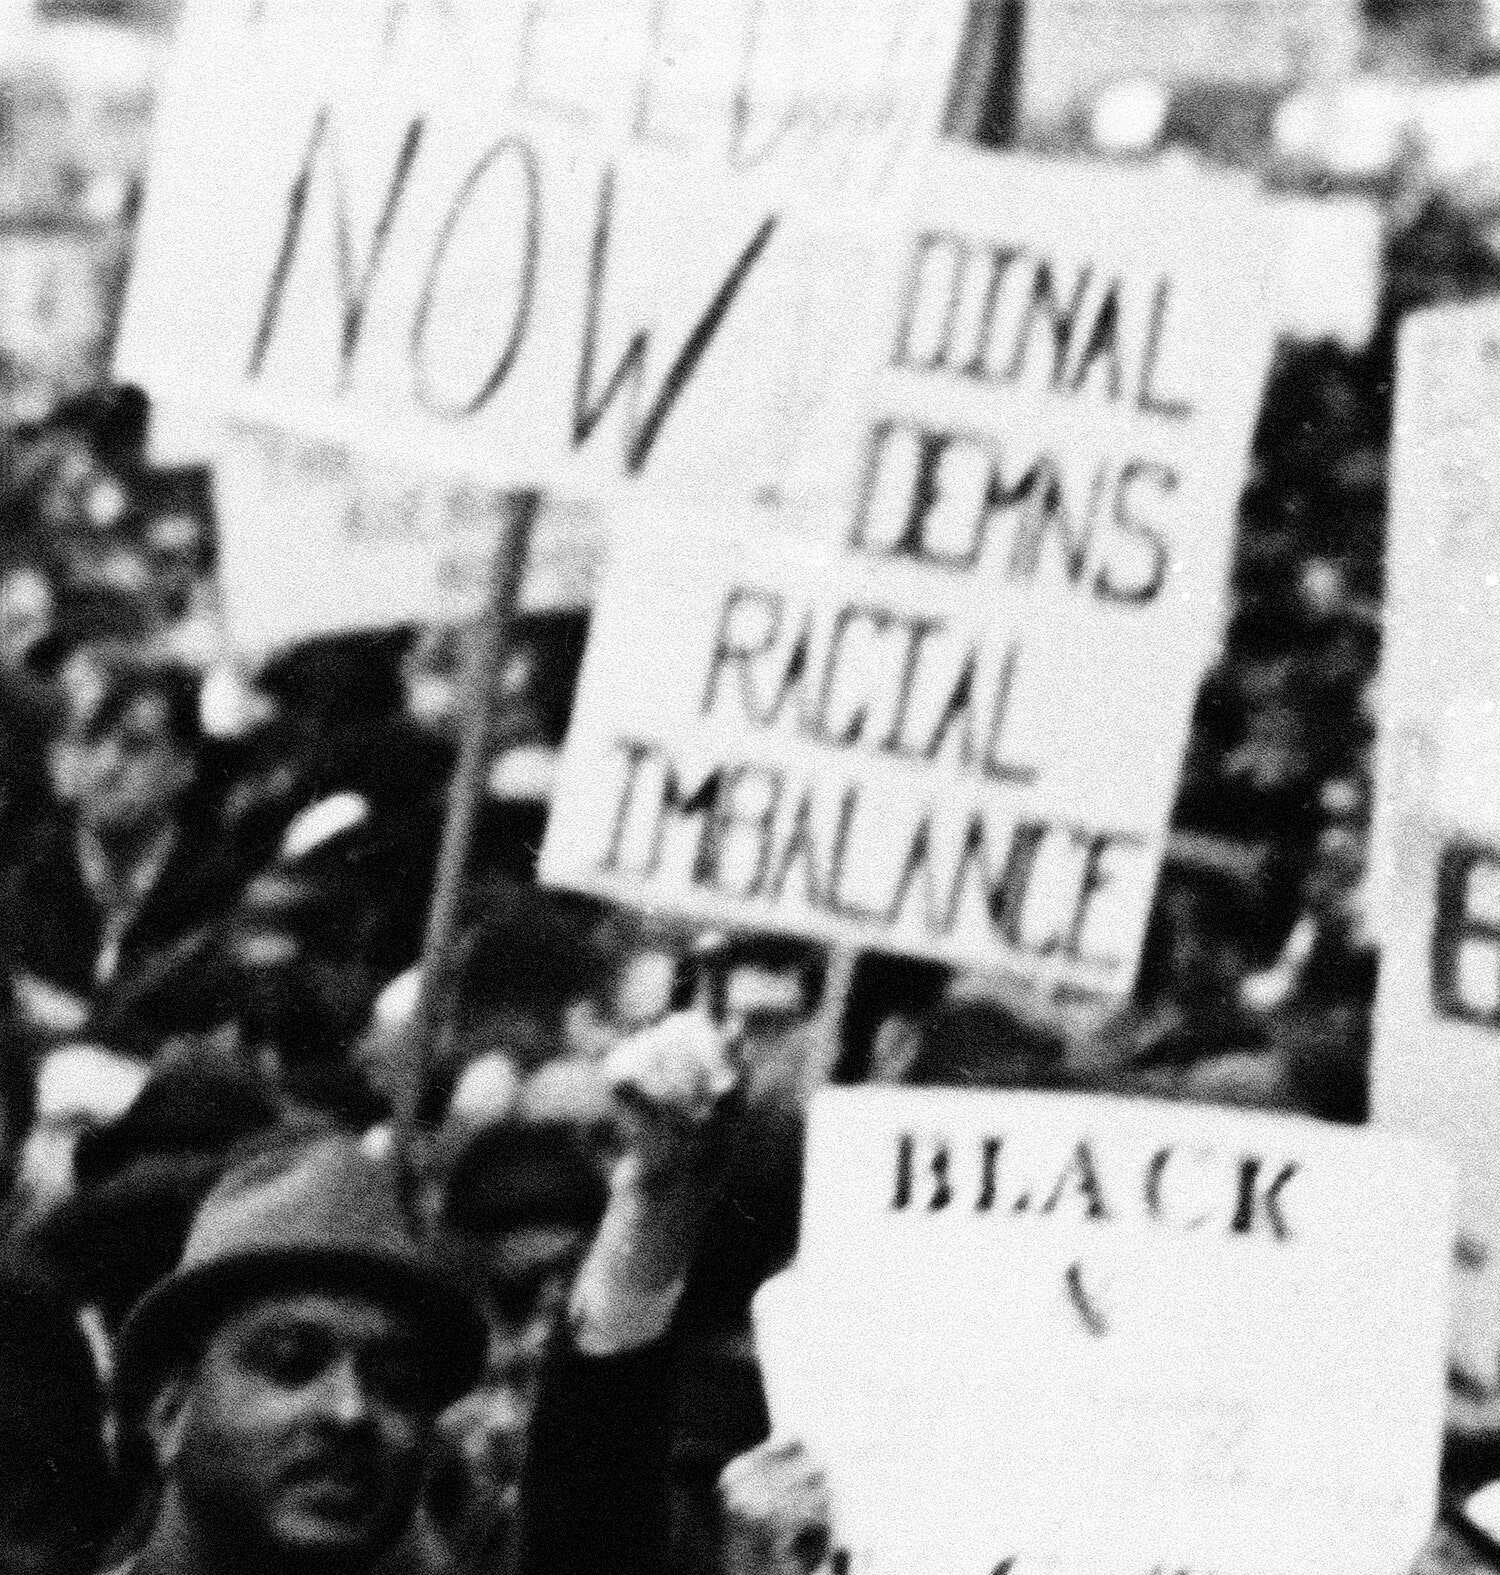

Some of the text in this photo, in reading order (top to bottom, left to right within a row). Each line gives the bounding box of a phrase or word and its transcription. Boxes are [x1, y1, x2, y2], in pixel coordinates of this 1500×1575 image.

[703, 586, 1041, 783] RACIAL
[600, 738, 1146, 975] IMBALANCE
[884, 1125, 1306, 1249] BLACK
